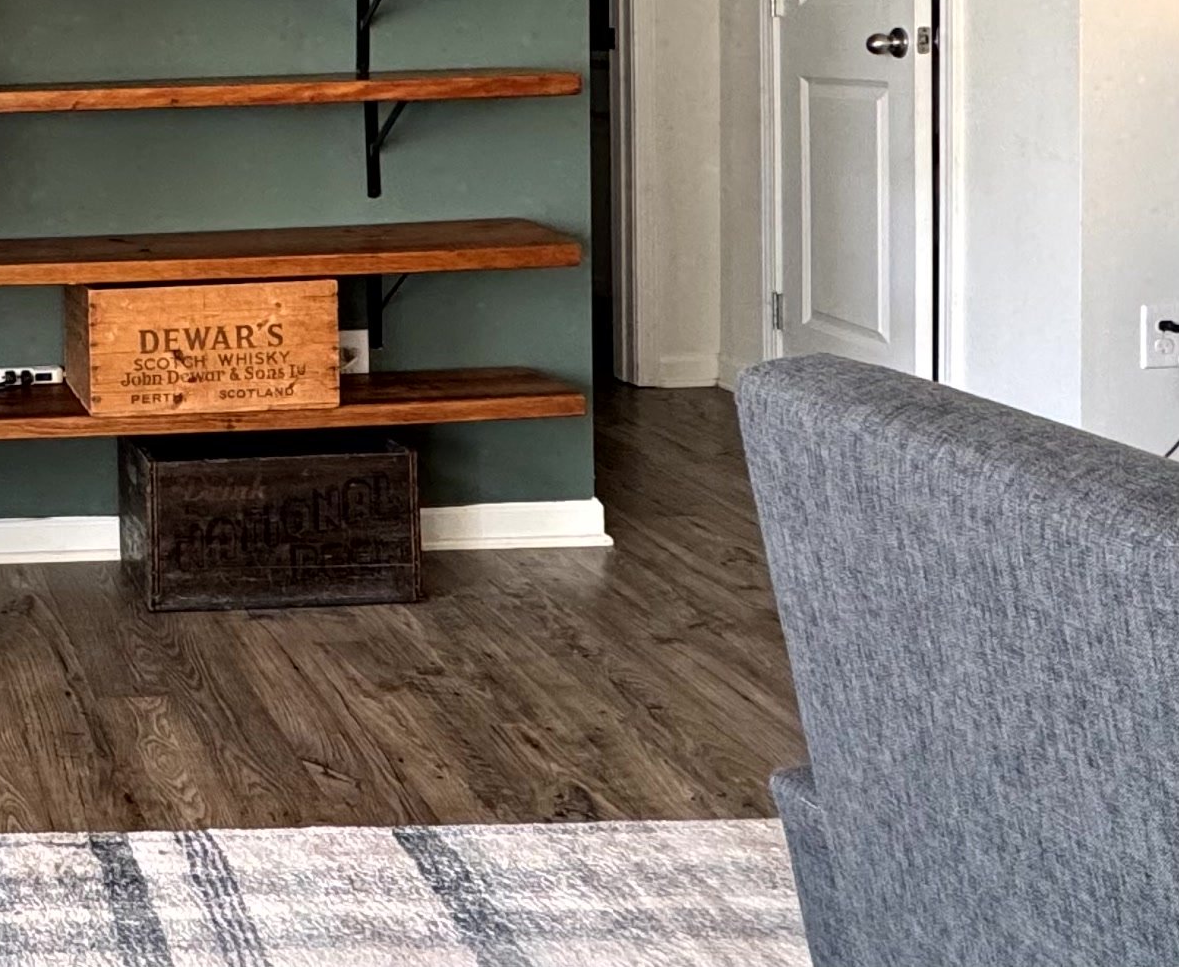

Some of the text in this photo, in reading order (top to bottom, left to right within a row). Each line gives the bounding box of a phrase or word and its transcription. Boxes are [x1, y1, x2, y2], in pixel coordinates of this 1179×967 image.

[138, 323, 284, 354] DEWAR'S
[133, 350, 290, 371] SCOTCH WHISKY
[120, 371, 163, 387] John
[167, 367, 225, 384] Dewar
[229, 366, 241, 381] &
[244, 365, 285, 380] Sons
[219, 387, 294, 401] SCOTLAND
